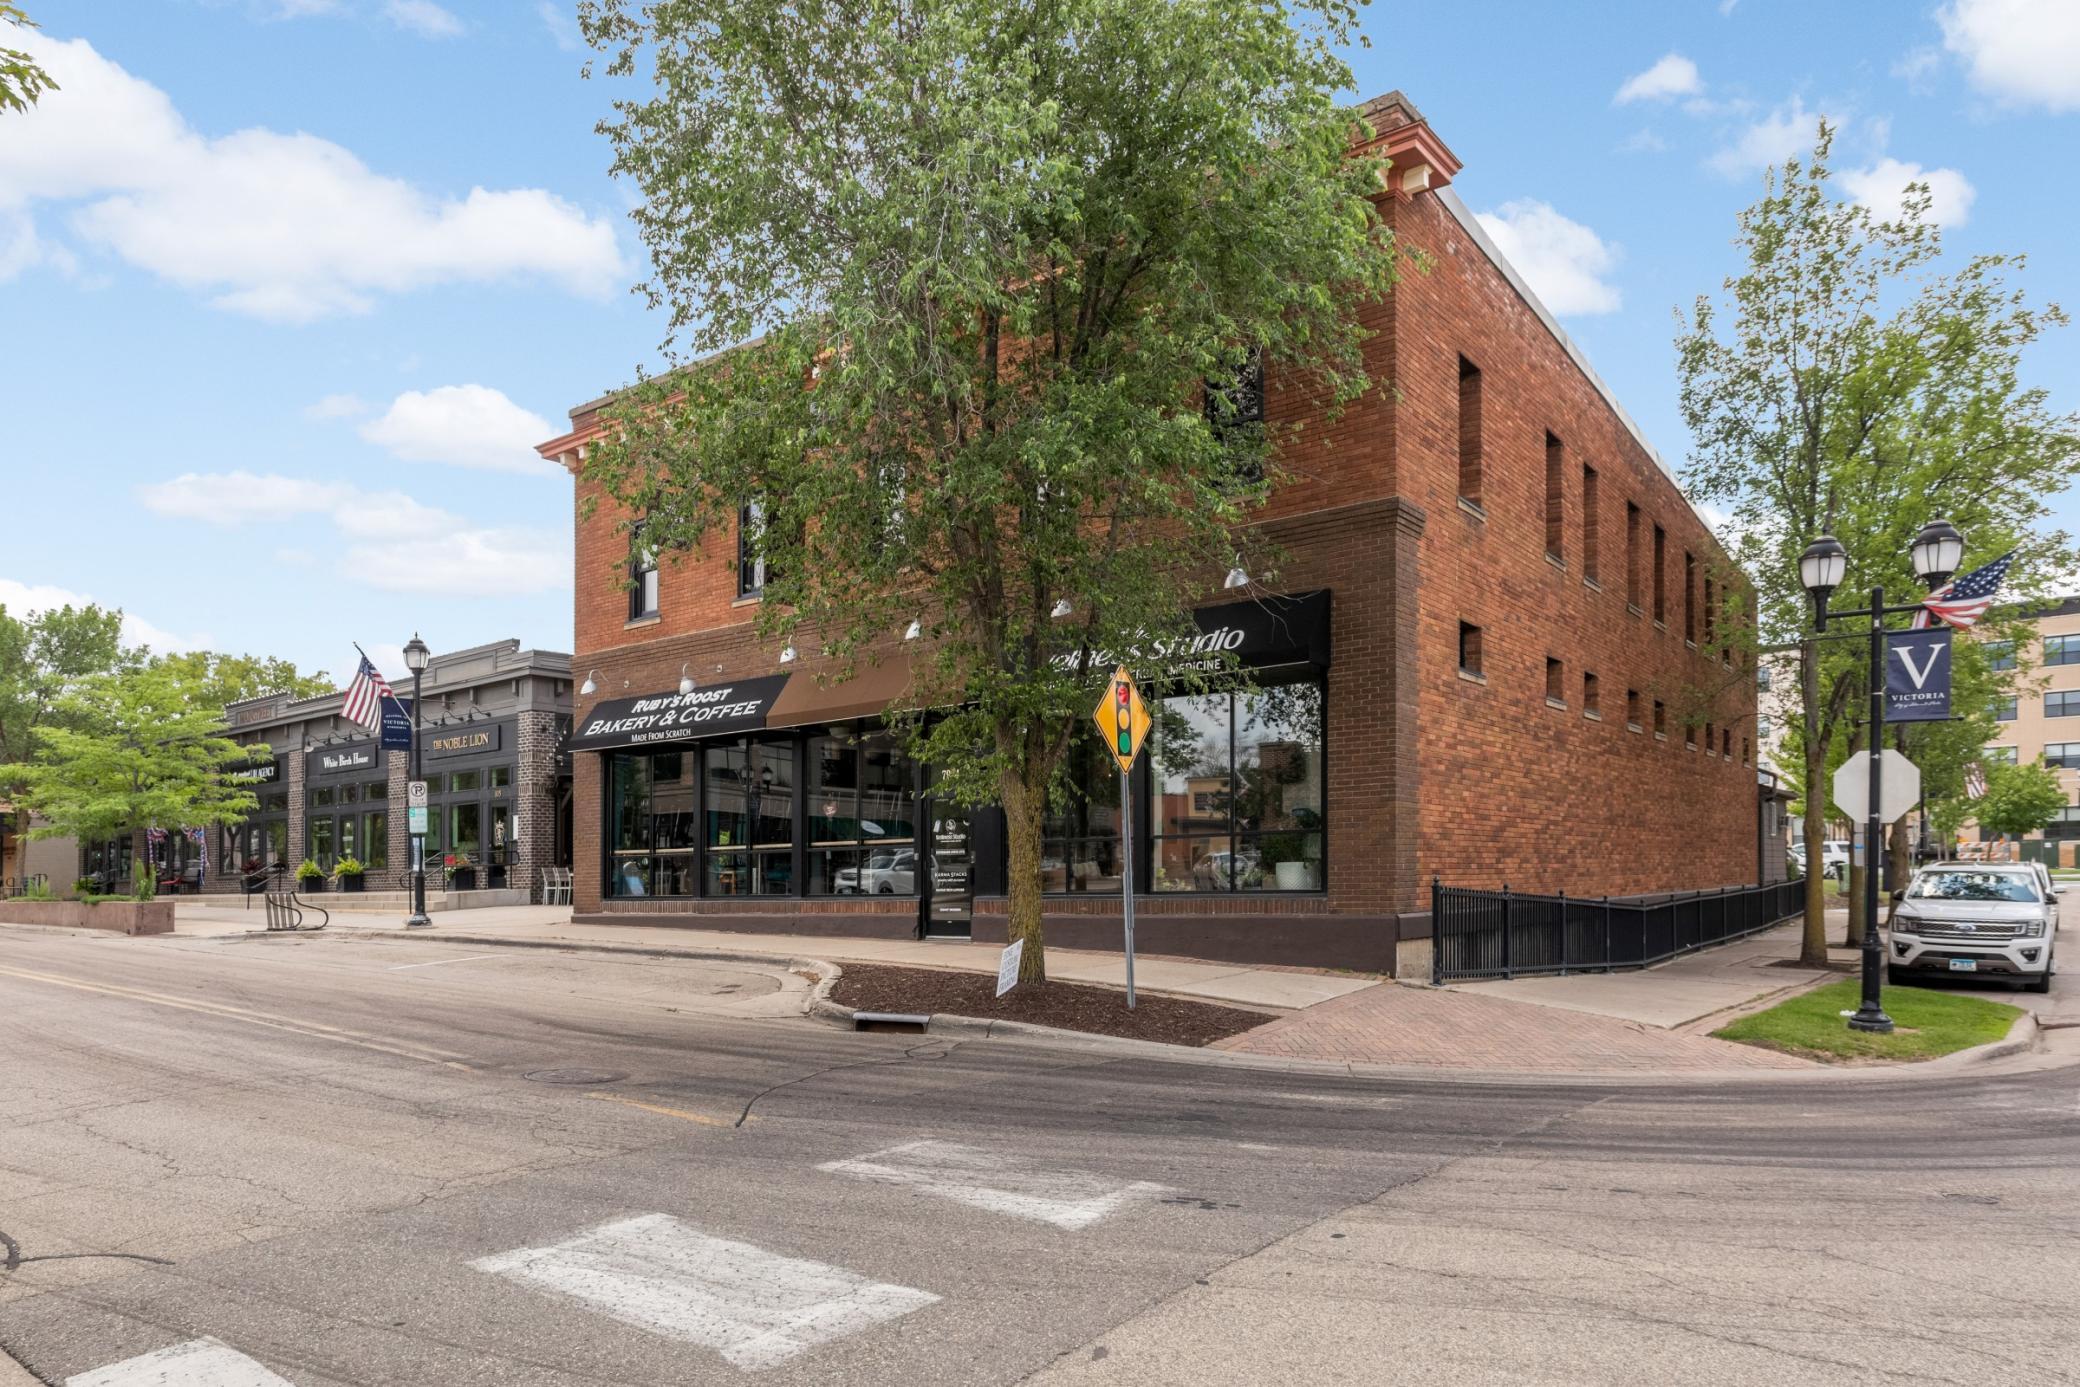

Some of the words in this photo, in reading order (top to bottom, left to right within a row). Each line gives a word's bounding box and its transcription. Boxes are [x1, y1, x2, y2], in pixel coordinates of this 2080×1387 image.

[1147, 626, 1245, 660] Studio
[1891, 643, 1947, 690] V
[631, 695, 682, 713] RUBY'S
[680, 688, 733, 706] ROOST
[1891, 692, 1945, 701] VICTORIA
[584, 714, 660, 736] BAKERY
[659, 710, 678, 726] &
[679, 700, 763, 724] COFFEE
[442, 736, 468, 750] NOBLE
[469, 732, 490, 747] LION
[631, 733, 647, 743] MADE
[648, 731, 665, 741] FROM
[665, 728, 691, 740] SCRATCH
[323, 756, 338, 769] White
